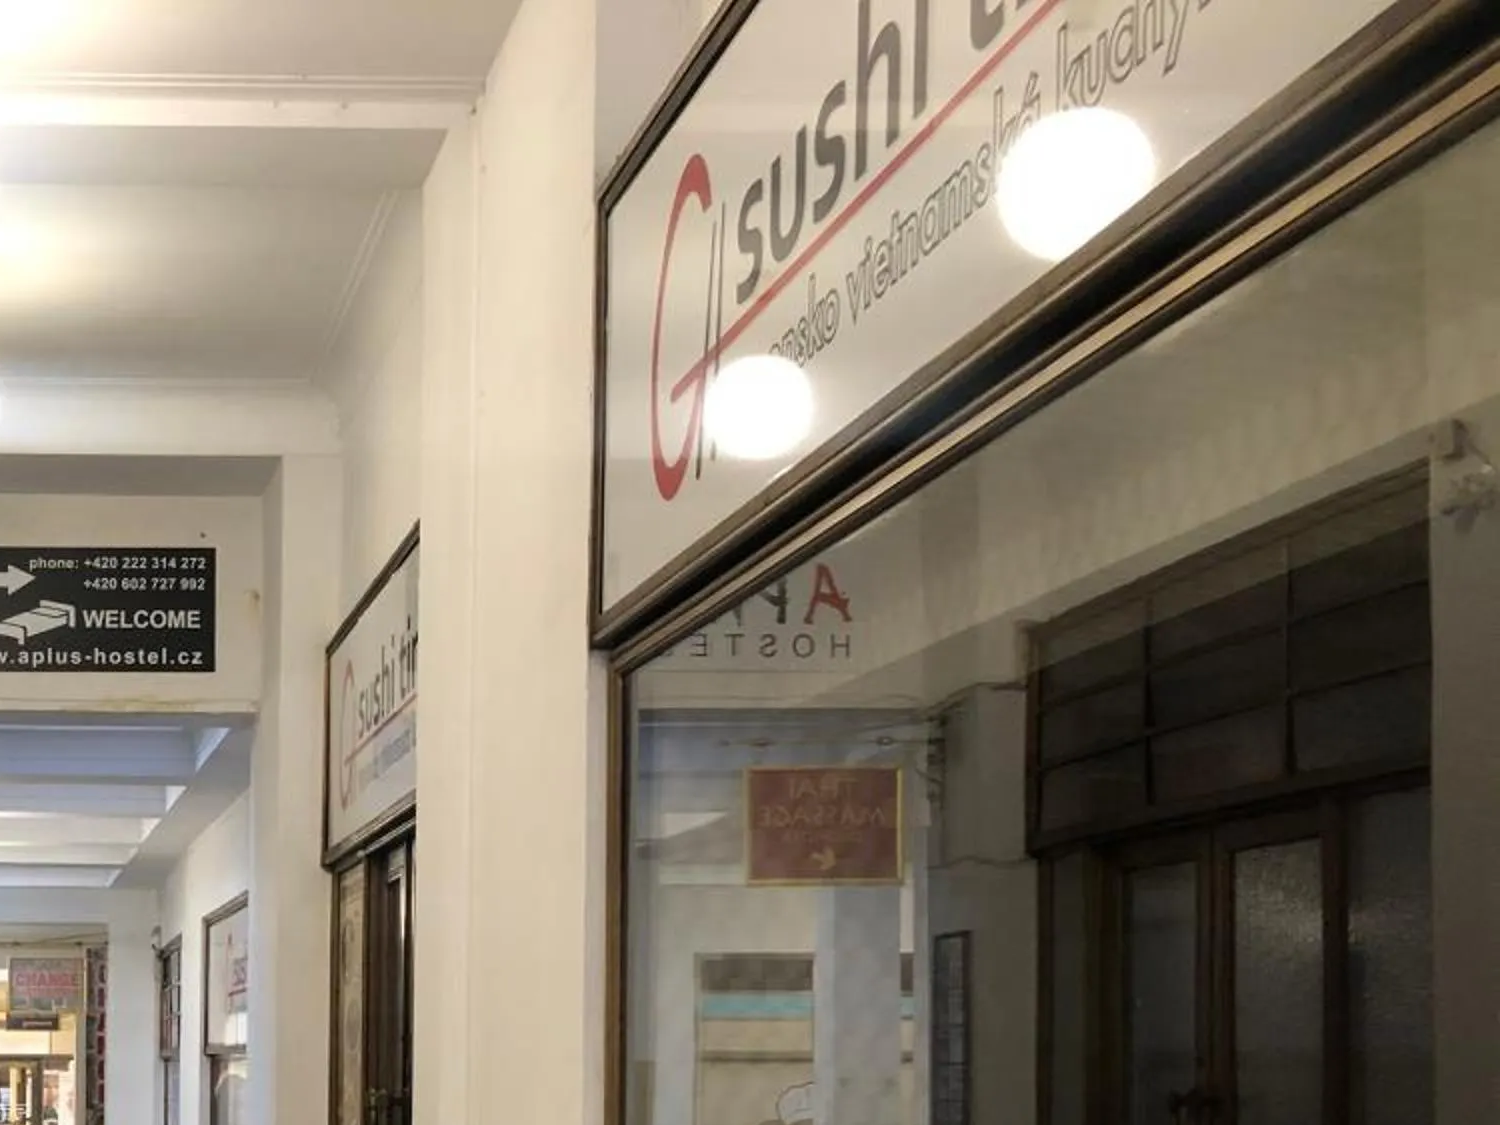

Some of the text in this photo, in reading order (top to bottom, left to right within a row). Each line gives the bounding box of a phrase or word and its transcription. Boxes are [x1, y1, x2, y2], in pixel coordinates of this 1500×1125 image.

[1057, 0, 1211, 112] kuchy
[737, 0, 928, 303] sushi
[29, 557, 207, 571] phone: +420 222 314 272
[84, 578, 117, 590] +420
[151, 578, 177, 590] 727
[82, 610, 201, 628] WELCOME
[358, 634, 396, 740] sushi
